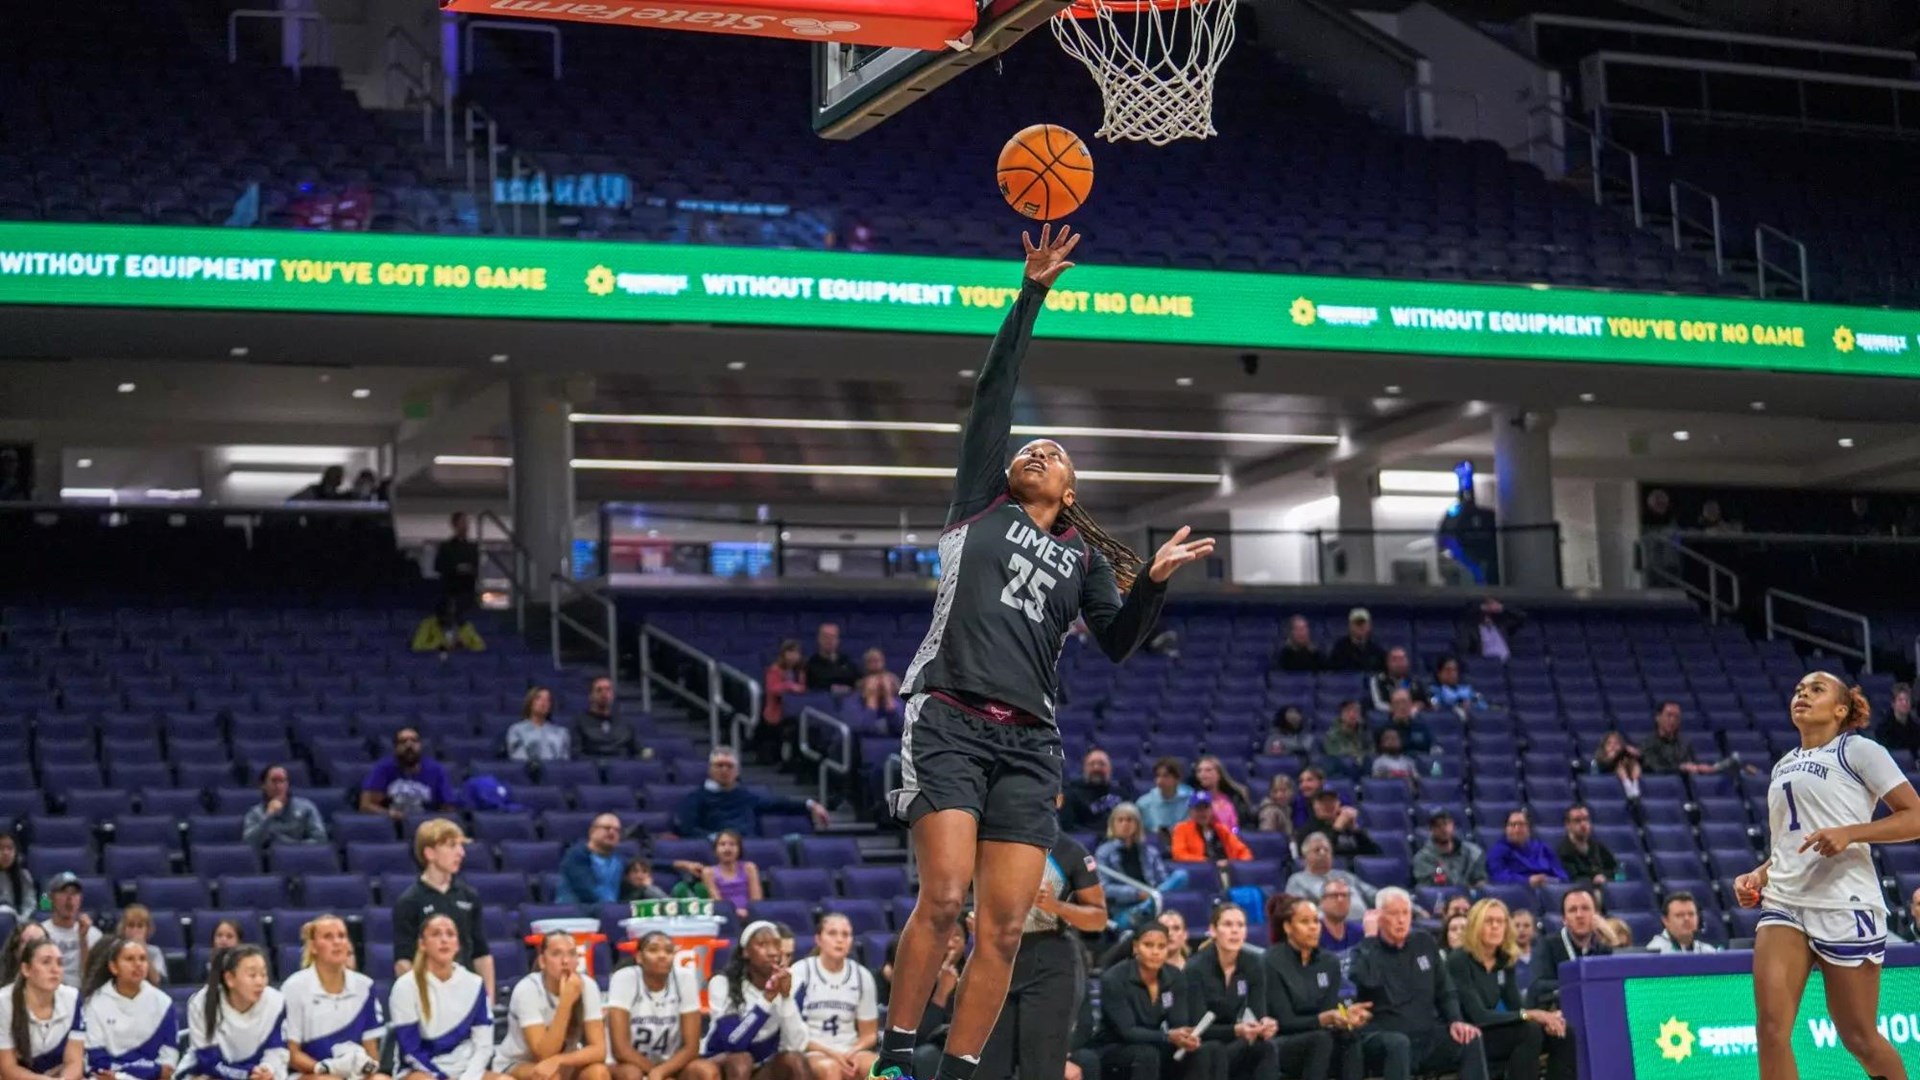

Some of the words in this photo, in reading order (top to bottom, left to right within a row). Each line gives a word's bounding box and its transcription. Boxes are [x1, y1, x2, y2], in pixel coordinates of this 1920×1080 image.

[0, 252, 119, 276] WITHOUT
[125, 254, 275, 281] EQUIPMENT
[280, 259, 373, 284] YOU'VE
[378, 263, 428, 287] GOT
[433, 265, 470, 288] NO
[475, 266, 547, 290] GAME
[702, 273, 814, 298] WITHOUT
[818, 278, 954, 305] EQUIPMENT
[957, 285, 1022, 308] YOU'V
[1045, 289, 1090, 312] GOT
[1094, 293, 1127, 314] NO
[1130, 293, 1193, 318] GAME
[1390, 306, 1484, 330] WITHOUT
[1488, 311, 1602, 336] EQUIPMENT
[1607, 316, 1676, 341] YOU'VE
[1680, 320, 1717, 342] GOT
[1721, 323, 1748, 344] NO
[1752, 324, 1805, 348] GAME
[1005, 520, 1077, 578] UMES
[1000, 552, 1057, 623] 25
[1782, 781, 1801, 832] 1
[1854, 909, 1877, 938] N
[631, 1026, 670, 1057] 24
[822, 1014, 839, 1037] 4
